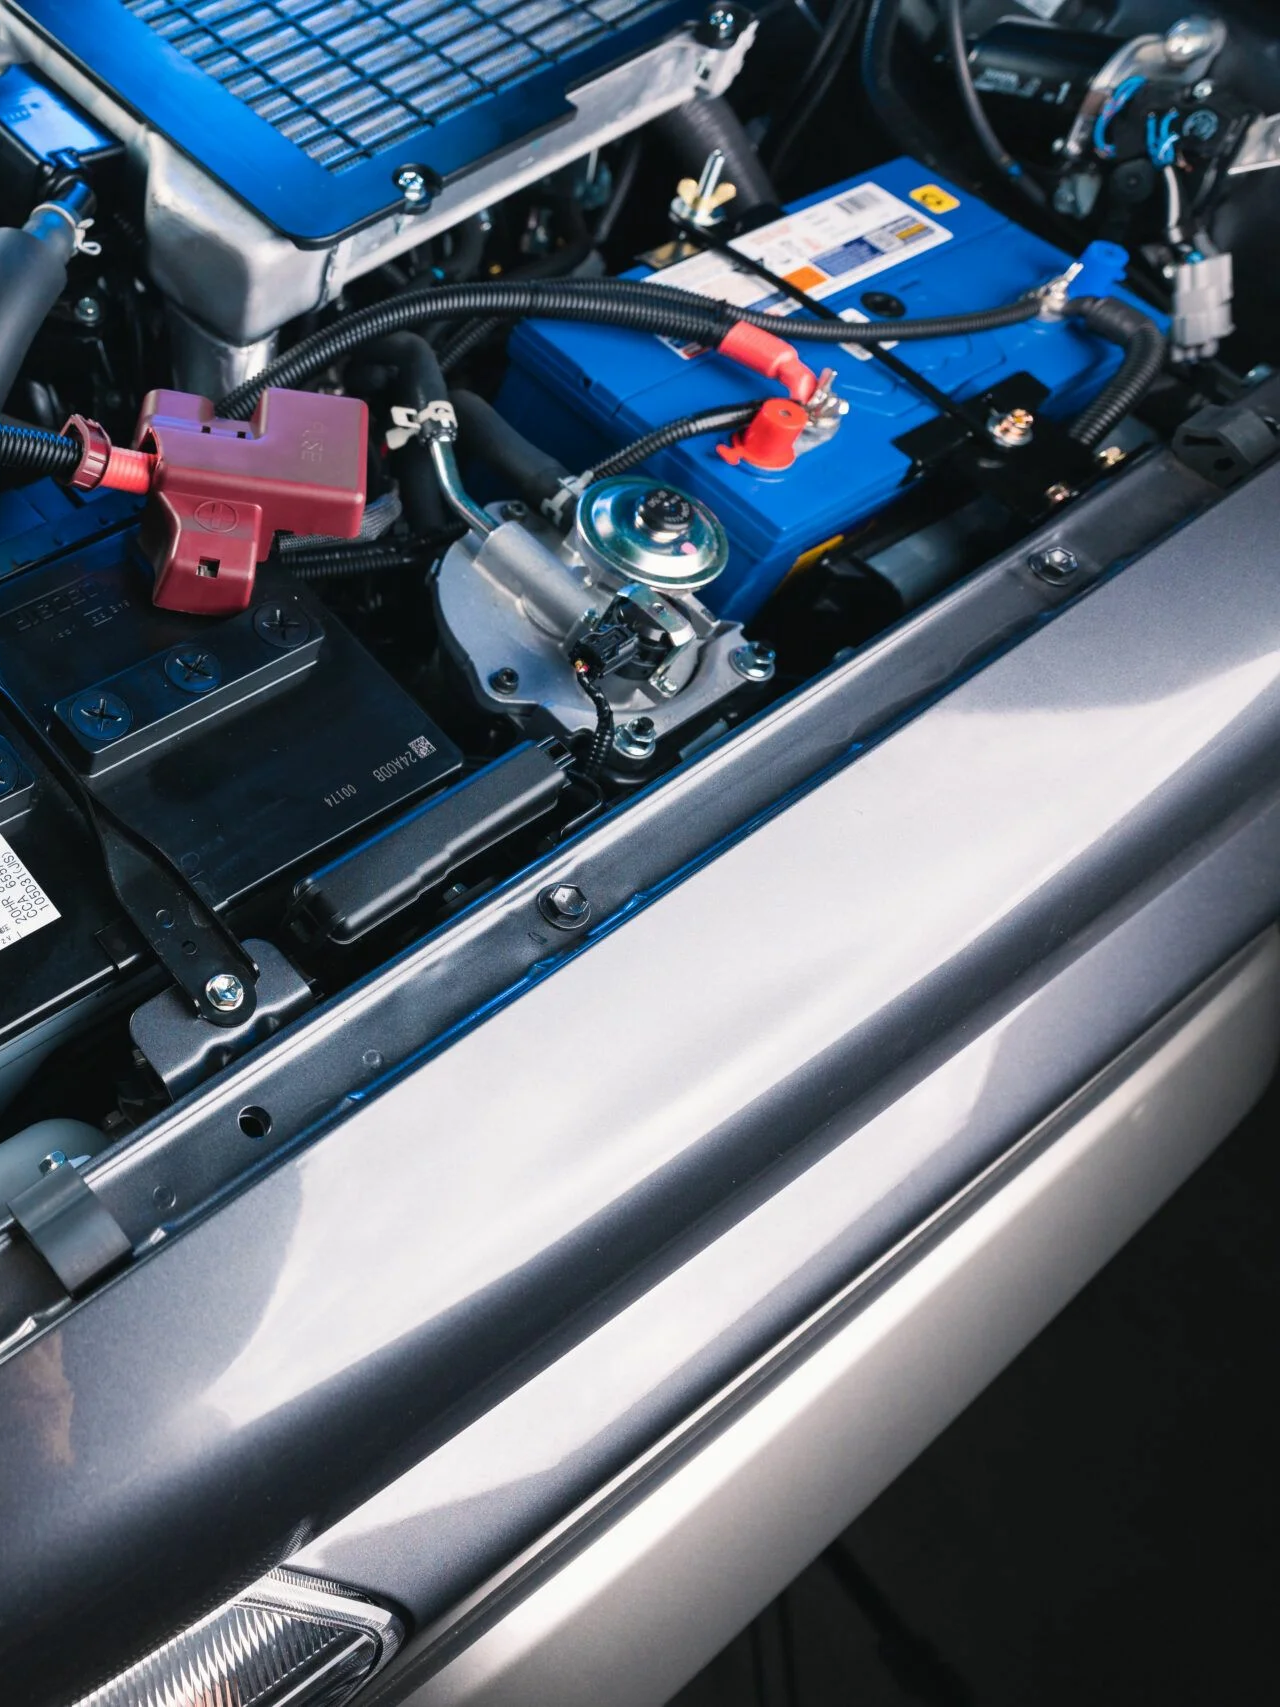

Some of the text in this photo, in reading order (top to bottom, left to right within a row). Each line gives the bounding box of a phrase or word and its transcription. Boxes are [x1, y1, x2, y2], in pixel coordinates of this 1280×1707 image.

[323, 784, 357, 808] 00174
[1, 851, 50, 911] 105D31(JIS)
[1, 895, 27, 925] 20HR
[16, 894, 38, 919] CCA
